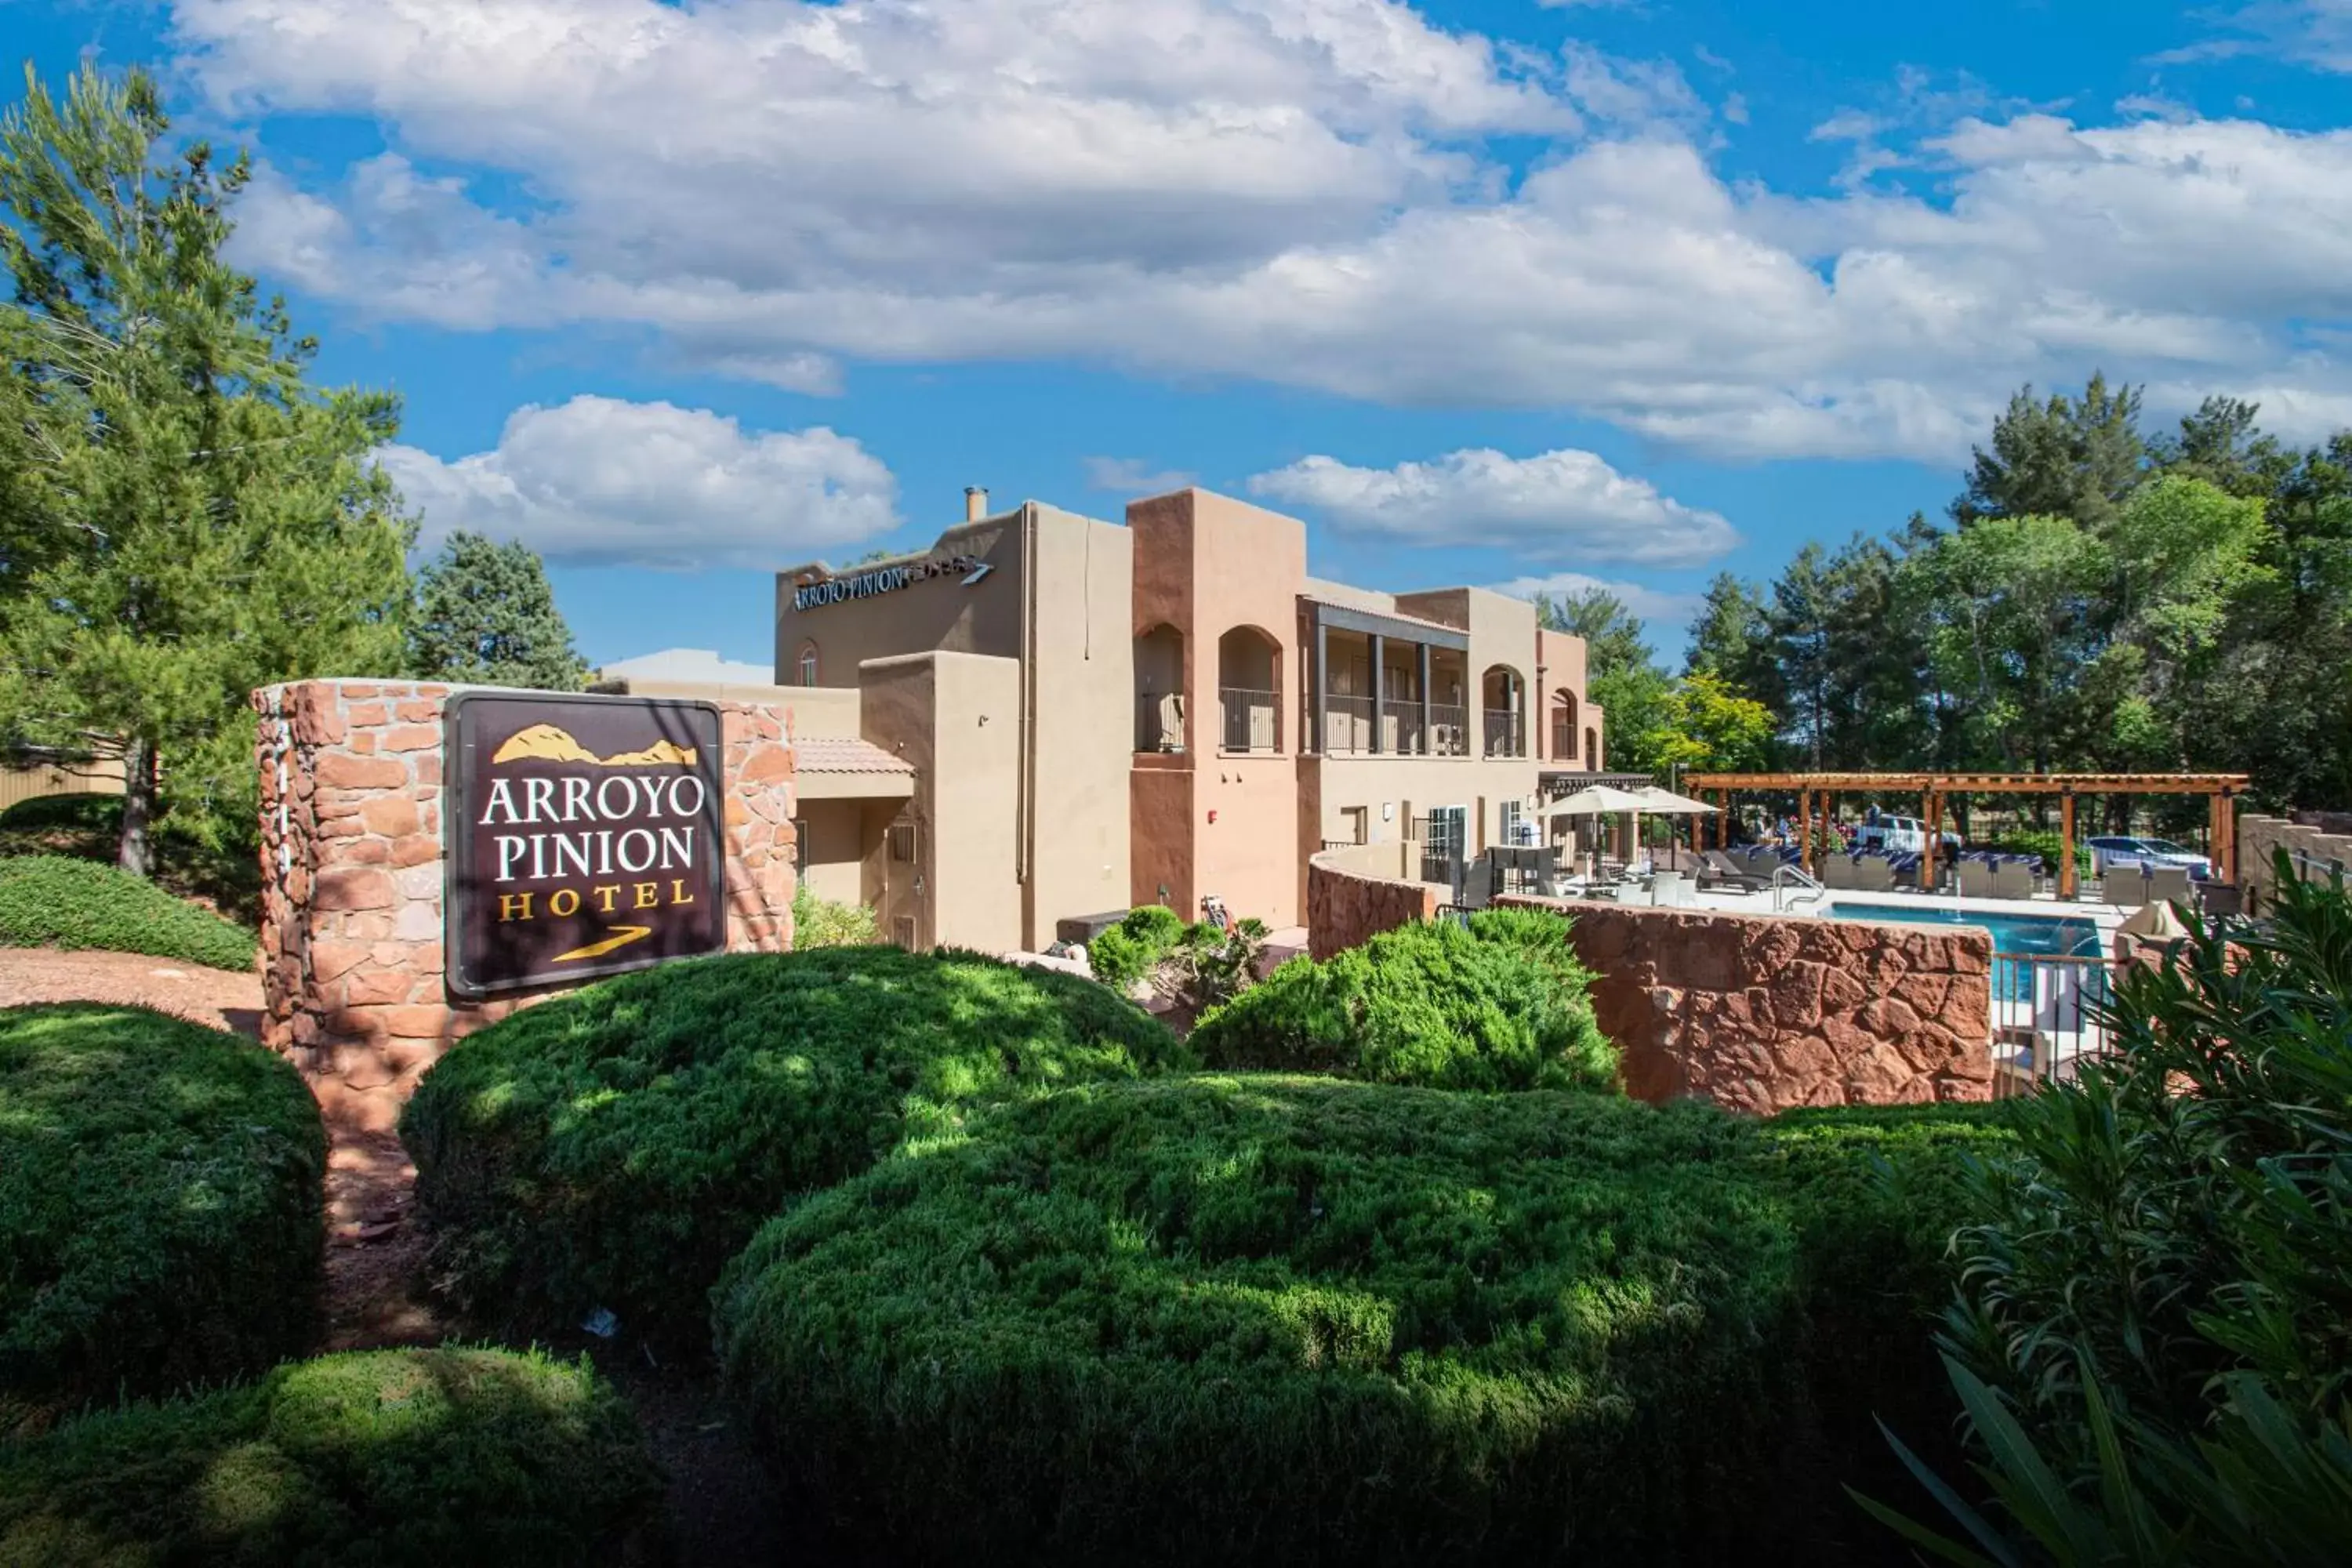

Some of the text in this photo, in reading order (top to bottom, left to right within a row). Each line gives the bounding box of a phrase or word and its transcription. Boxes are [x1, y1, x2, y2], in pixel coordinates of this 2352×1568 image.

[848, 567, 905, 601] PINION
[477, 775, 705, 826] ARROYO
[494, 826, 695, 882] PINION
[499, 879, 695, 922] HOTEL
